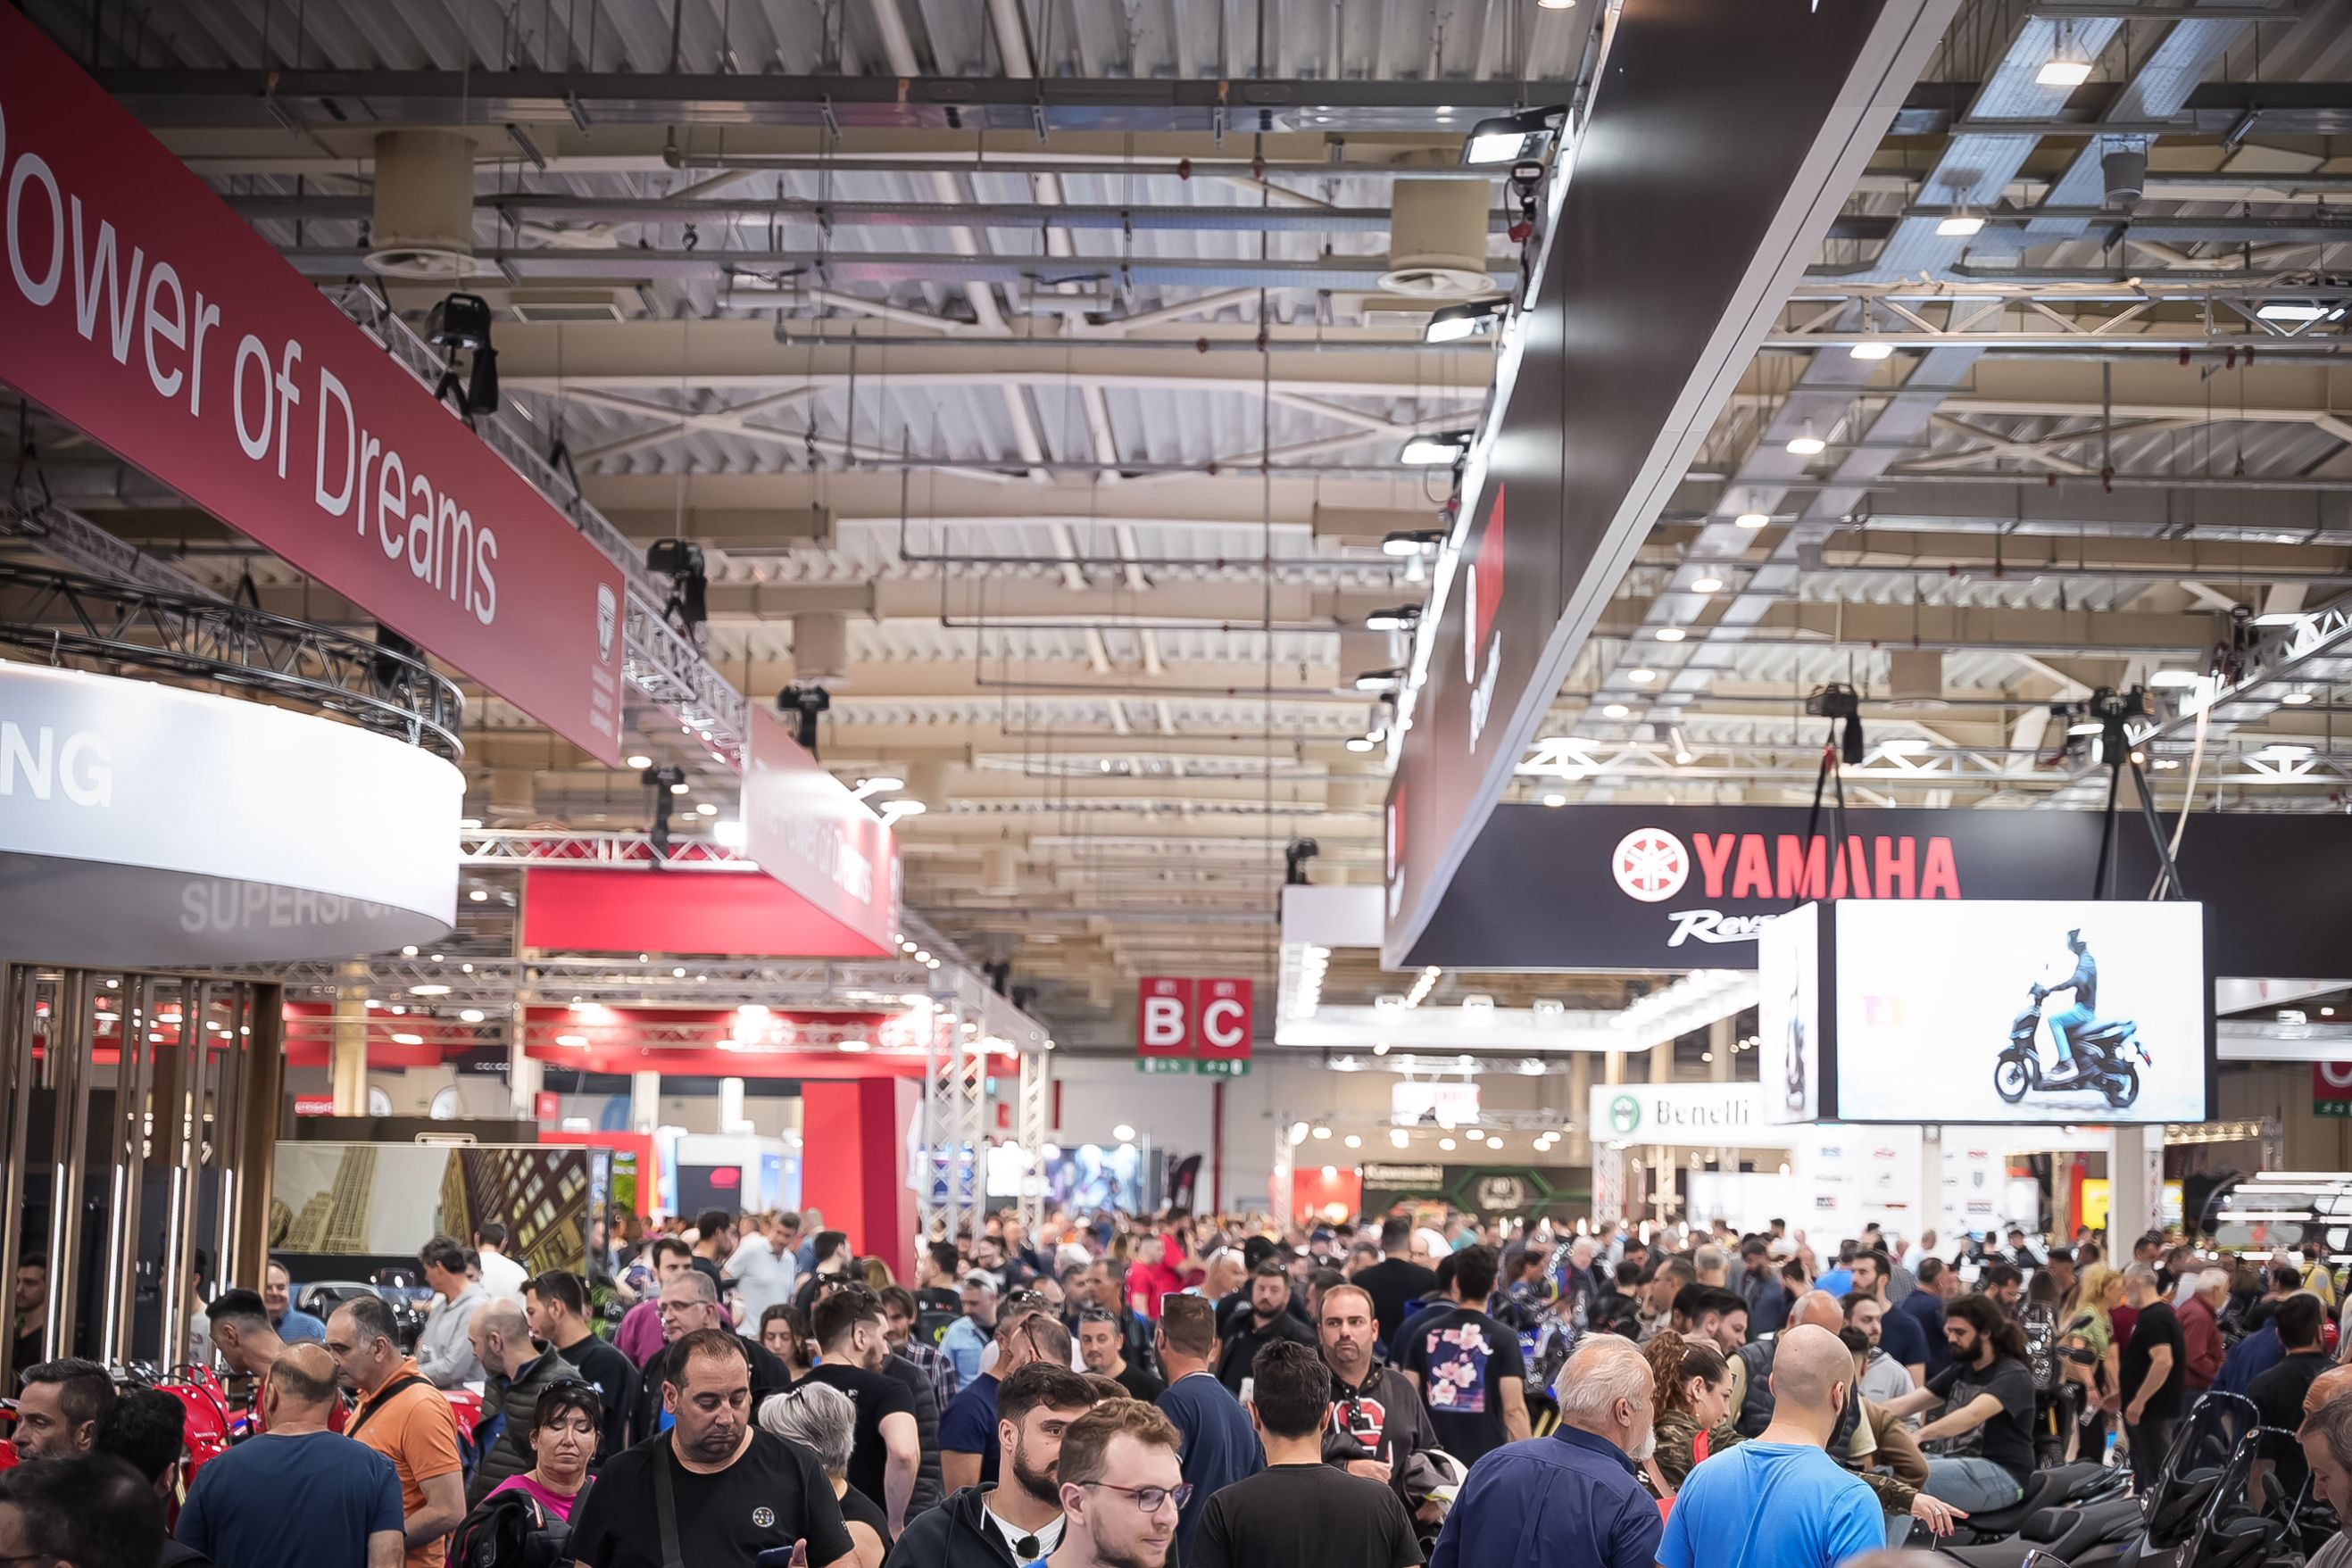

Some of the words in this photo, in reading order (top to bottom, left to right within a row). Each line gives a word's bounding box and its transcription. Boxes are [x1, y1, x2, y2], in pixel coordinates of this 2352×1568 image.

[0, 102, 220, 418] ower
[234, 334, 303, 480] of
[315, 367, 498, 626] Dreams
[0, 719, 112, 809] NG
[1691, 832, 1962, 900] YAMAHA
[1144, 995, 1185, 1046] B
[1203, 998, 1245, 1048] C
[1657, 1099, 1749, 1125] Benelli
